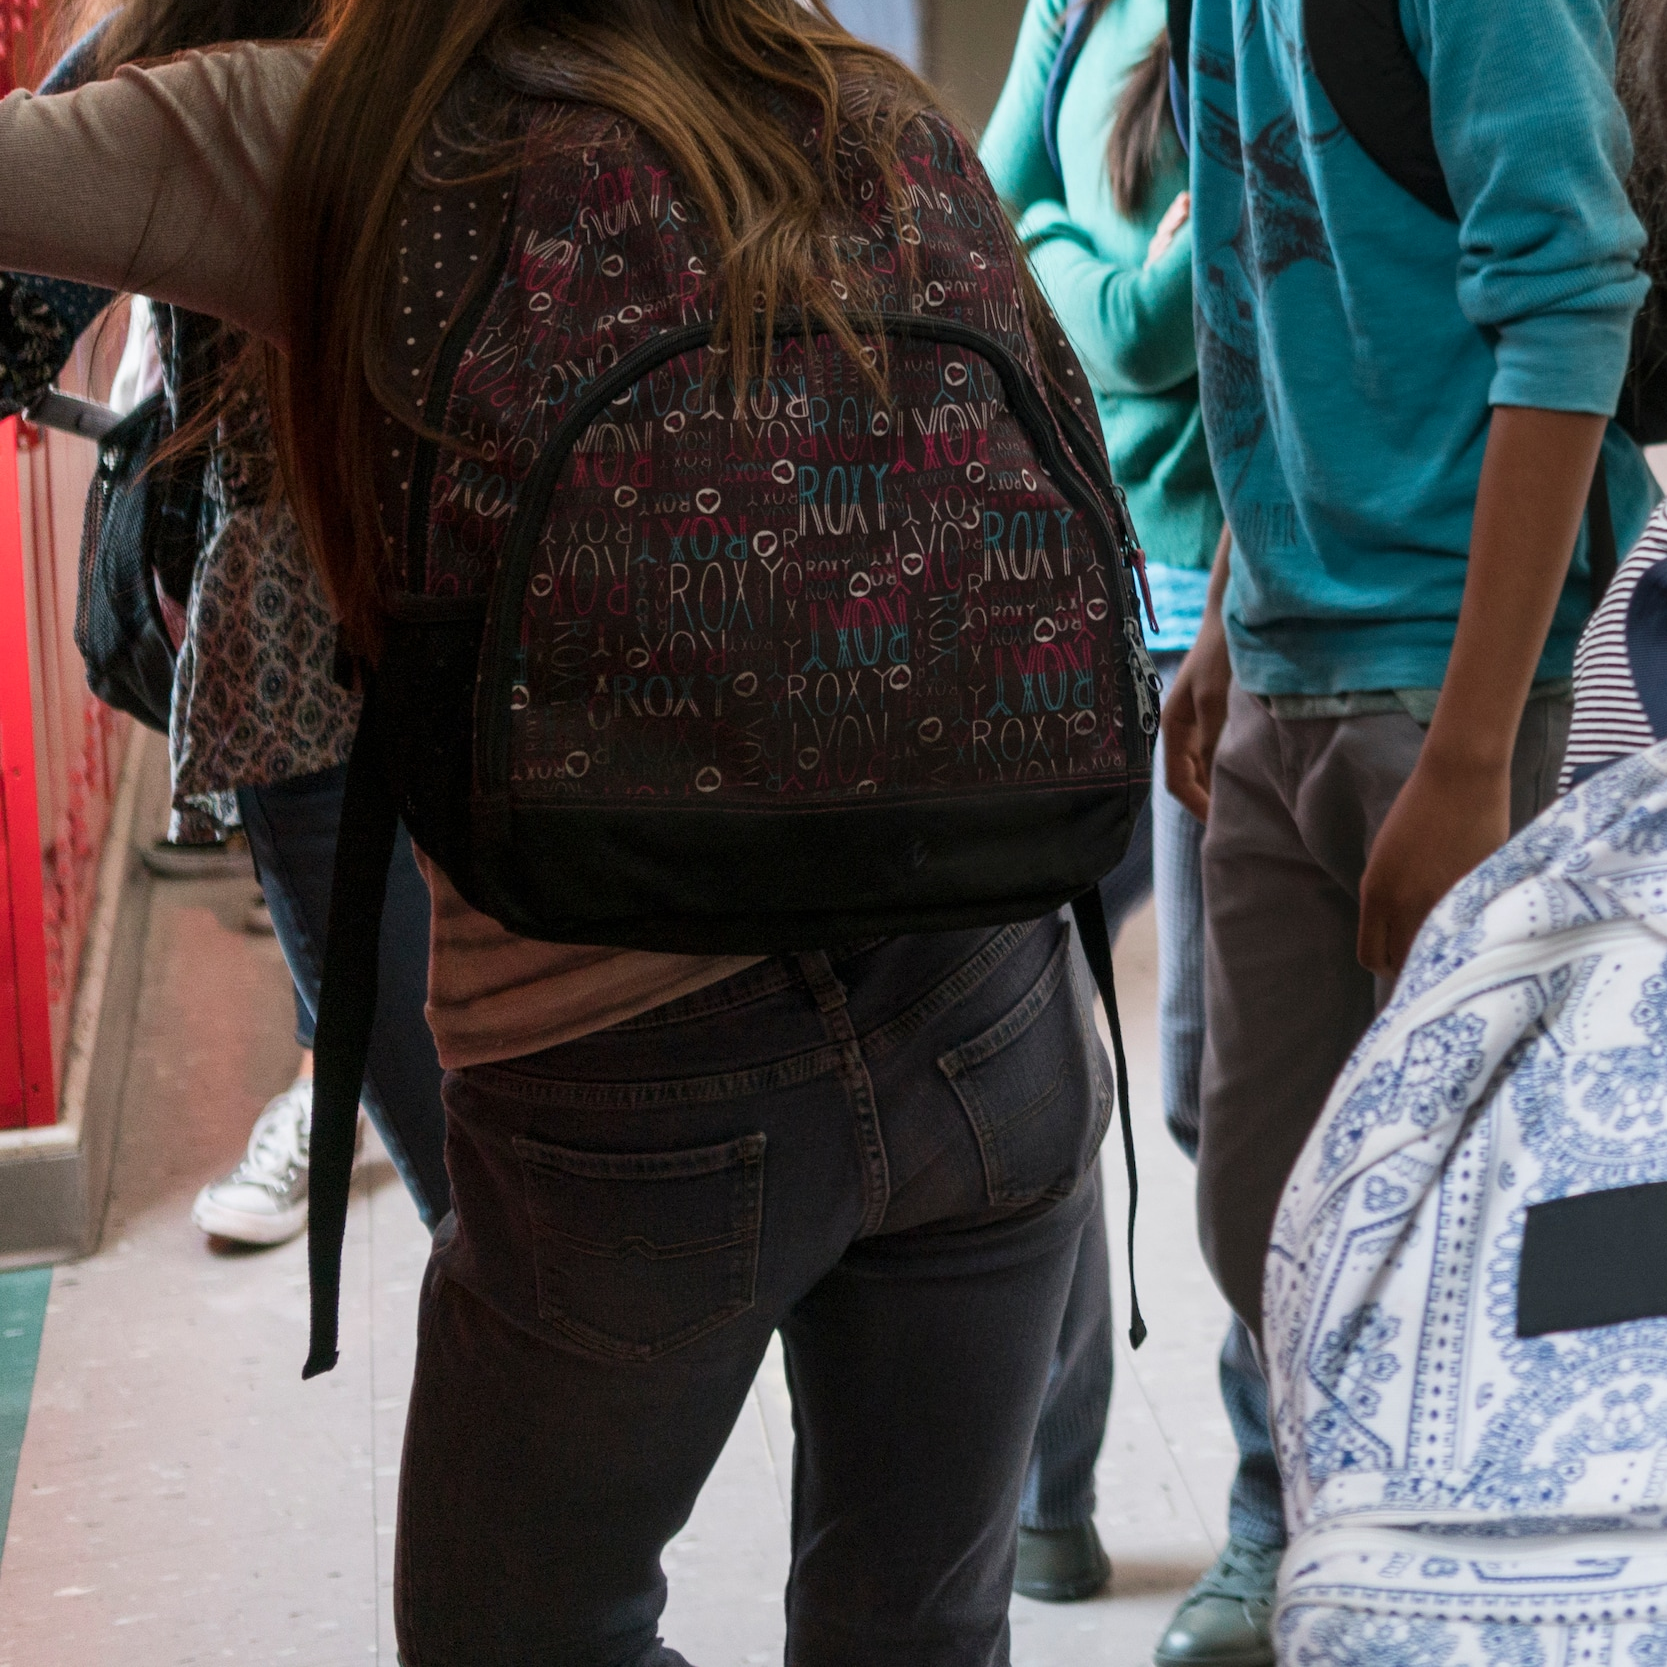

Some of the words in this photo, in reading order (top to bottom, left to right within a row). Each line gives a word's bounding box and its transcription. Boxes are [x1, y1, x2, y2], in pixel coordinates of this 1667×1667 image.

[891, 403, 990, 475] ROXY
[798, 463, 890, 536] ROXY
[631, 515, 750, 564] ROXY
[983, 510, 1074, 582] ROXY
[669, 560, 784, 633] ROXY
[801, 597, 909, 672] ROXY
[613, 674, 733, 718] ROXY
[788, 666, 894, 719] ROXY
[985, 639, 1095, 719] ROXY
[972, 713, 1079, 764] ROXY
